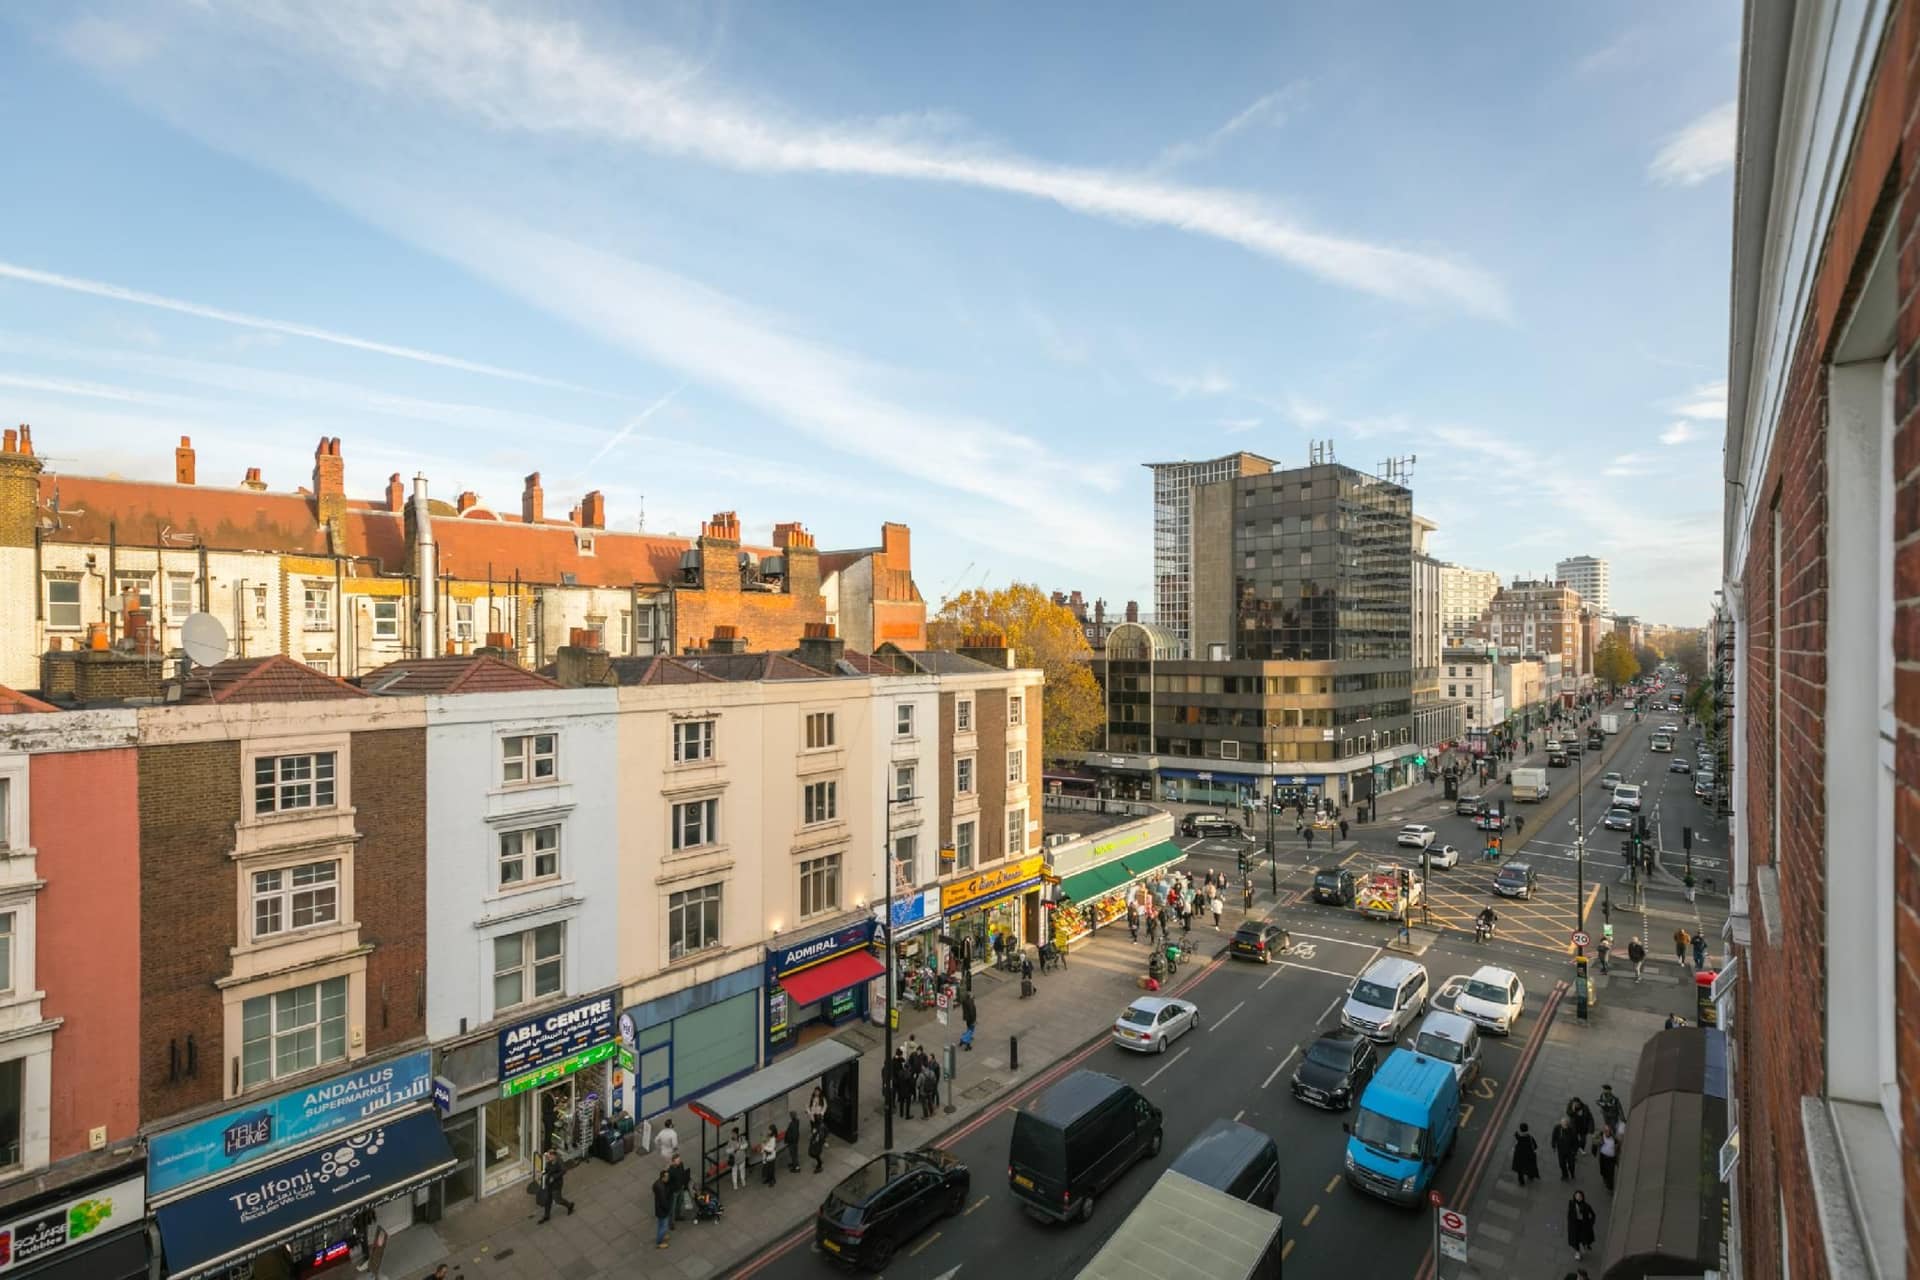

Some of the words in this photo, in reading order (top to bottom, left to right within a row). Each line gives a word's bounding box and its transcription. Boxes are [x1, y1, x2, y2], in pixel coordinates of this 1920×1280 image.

[785, 937, 838, 965] ADMIRAL
[1575, 934, 1588, 944] 20
[505, 1023, 542, 1047] ABL
[545, 998, 611, 1031] CENTRE
[304, 1068, 394, 1107] ANDALUS
[305, 1083, 392, 1118] SUPERMARKET
[227, 1130, 269, 1153] HOME
[228, 1117, 269, 1141] TALK
[229, 1168, 312, 1210] Telfoni
[14, 1223, 68, 1250] SQUARE
